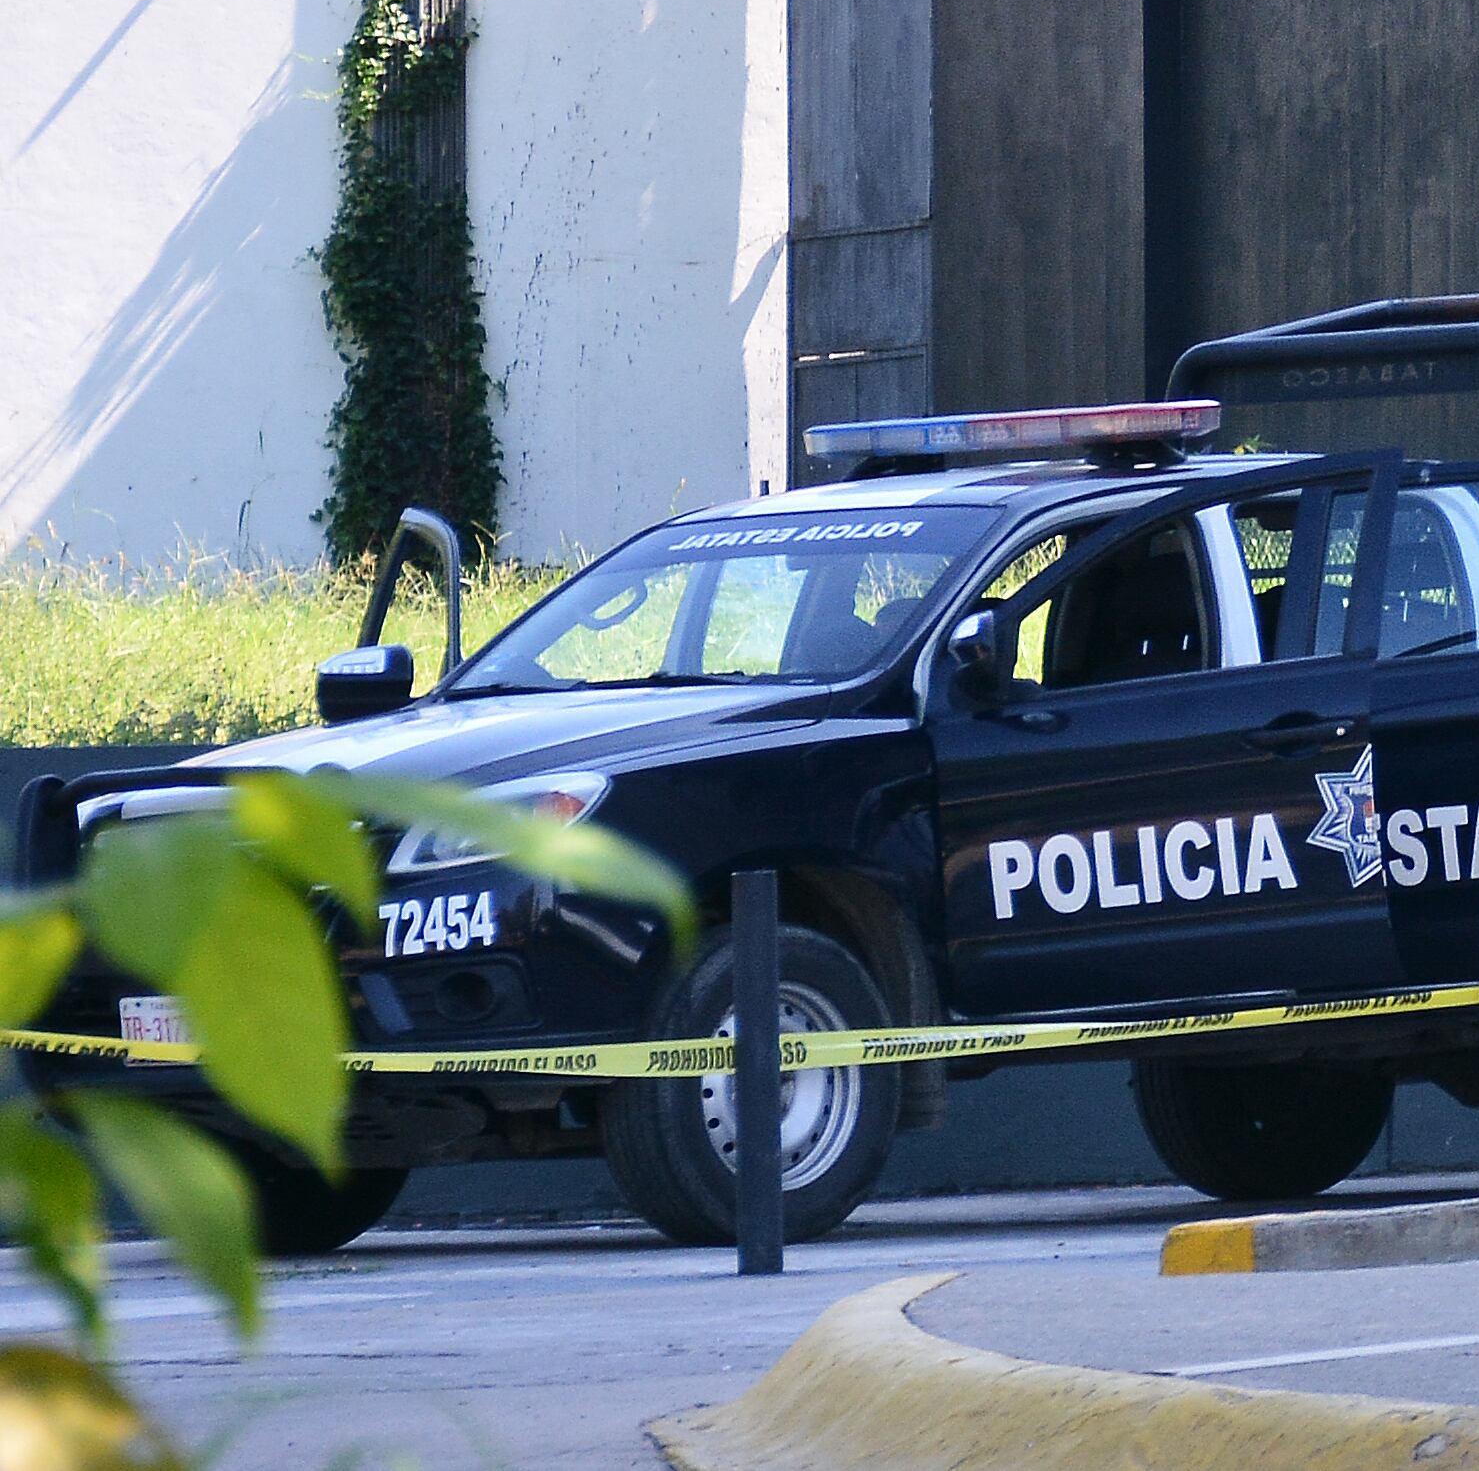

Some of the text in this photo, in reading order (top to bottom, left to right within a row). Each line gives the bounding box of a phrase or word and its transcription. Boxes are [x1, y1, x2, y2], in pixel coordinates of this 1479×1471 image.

[989, 813, 1298, 919] POLICIA
[378, 890, 495, 958] 72454
[553, 1053, 597, 1070] PASO
[645, 1045, 736, 1072] PROHIBIDO
[861, 1037, 959, 1059] PROHIBIDO
